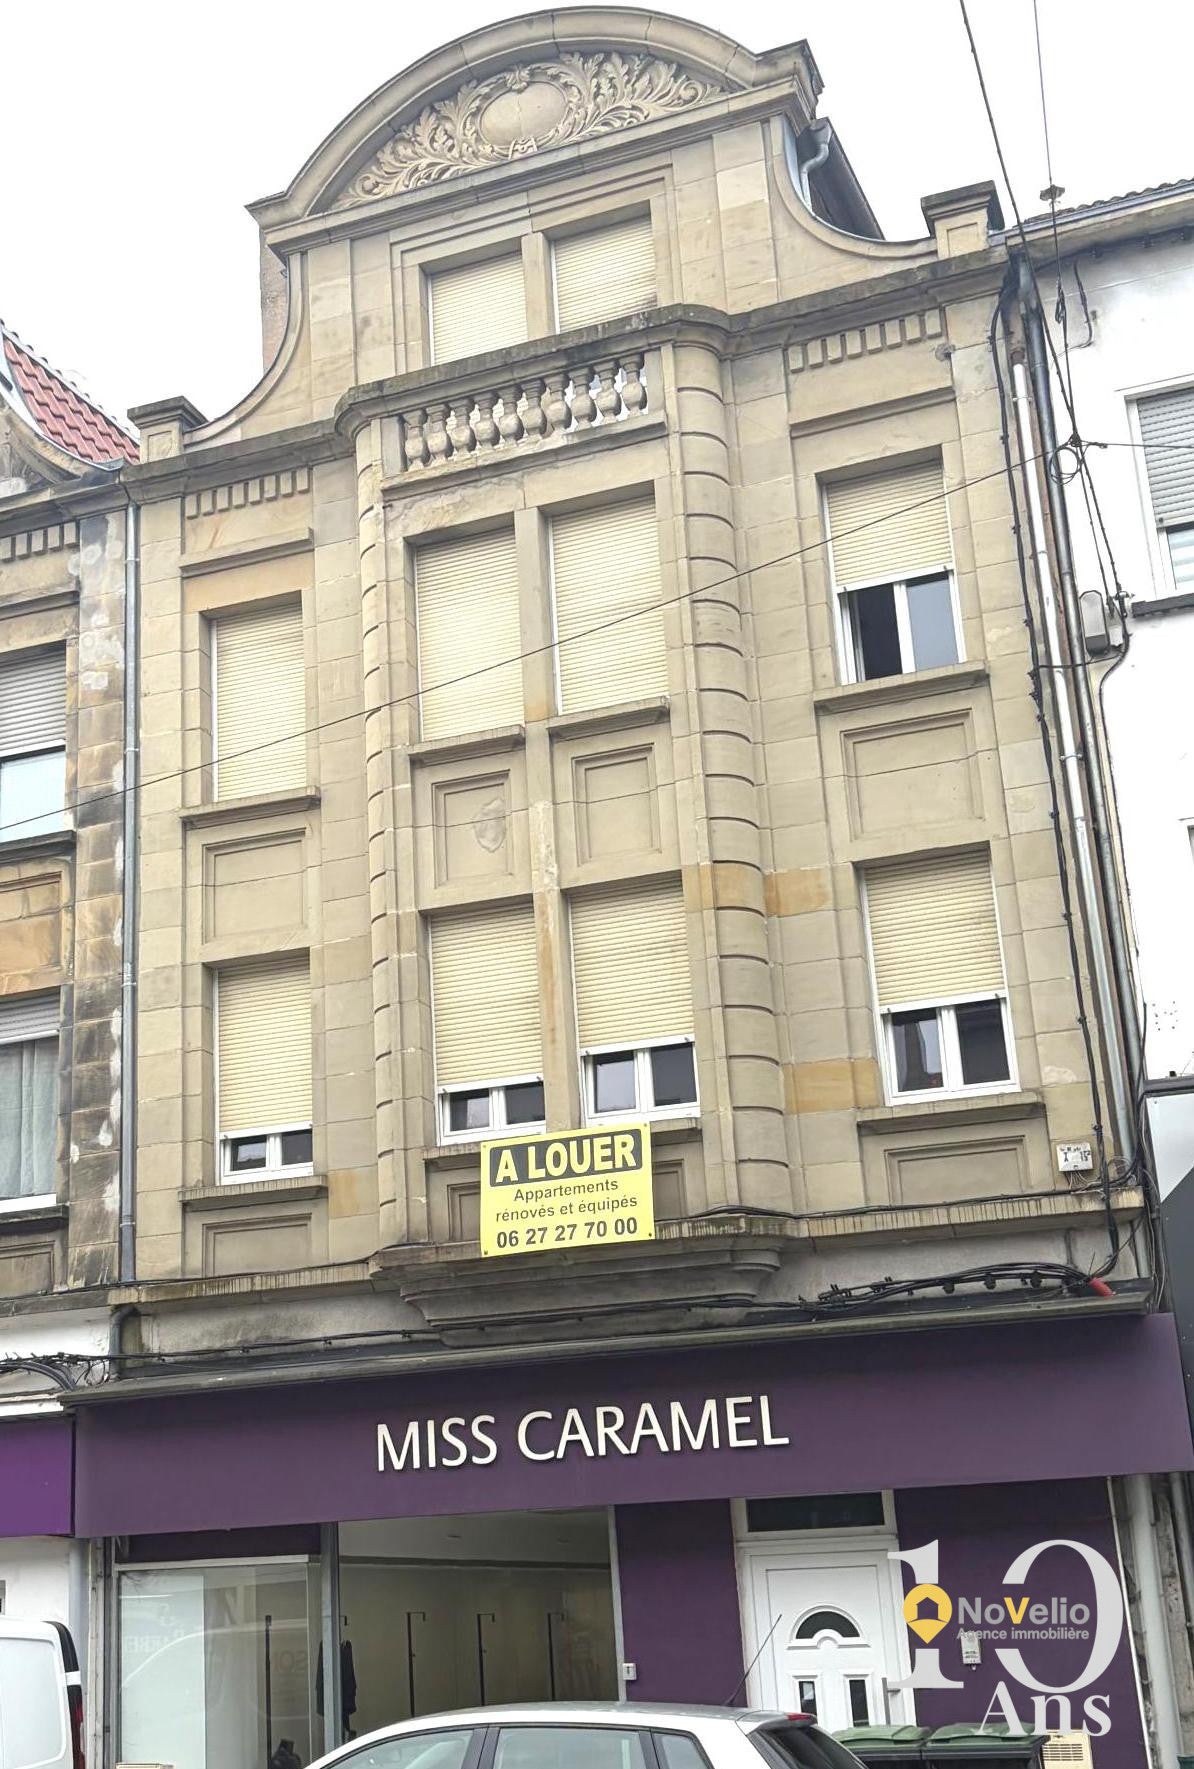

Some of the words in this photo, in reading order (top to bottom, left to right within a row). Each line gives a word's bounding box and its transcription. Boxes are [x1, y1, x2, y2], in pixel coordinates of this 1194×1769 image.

[495, 1149, 519, 1183] A
[527, 1134, 636, 1179] LOUER
[514, 1178, 618, 1203] Appartements
[496, 1204, 555, 1222] rénovés
[560, 1202, 573, 1215] et
[578, 1195, 638, 1215] équipés
[496, 1230, 519, 1248] 06
[525, 1226, 548, 1245] 27
[554, 1223, 578, 1242] 27
[584, 1220, 607, 1239] 70
[614, 1216, 638, 1235] 00
[377, 1414, 498, 1472] MISS
[517, 1395, 790, 1461] CARAMEL
